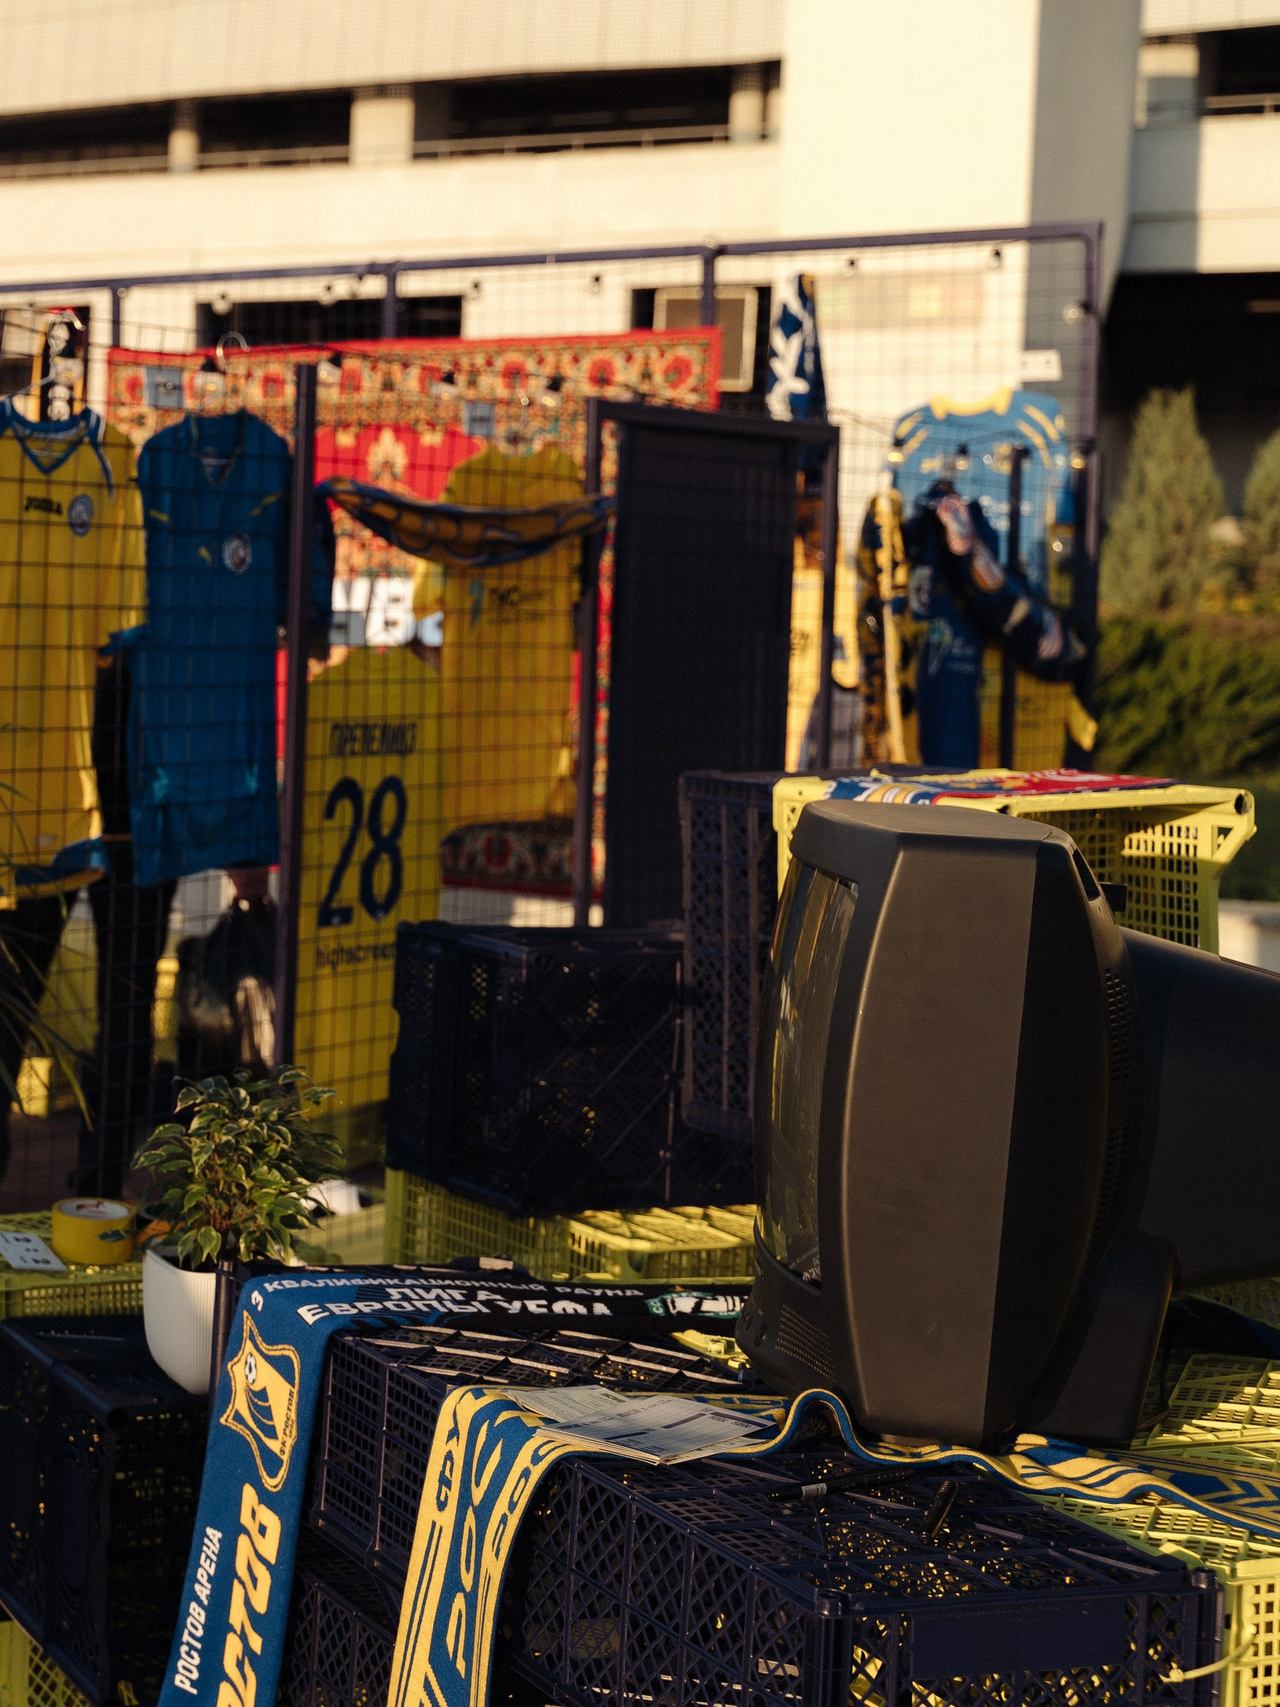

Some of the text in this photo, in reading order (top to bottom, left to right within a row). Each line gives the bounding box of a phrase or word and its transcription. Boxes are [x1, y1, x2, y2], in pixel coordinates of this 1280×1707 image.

[318, 775, 407, 927] 28
[251, 1290, 264, 1312] 3
[296, 1300, 492, 1328] ЕВРОПЫ
[385, 1287, 508, 1301] ЛИГА
[174, 1525, 223, 1695] РОСТОВ АРЕНА
[216, 1482, 282, 1707] СТОВ
